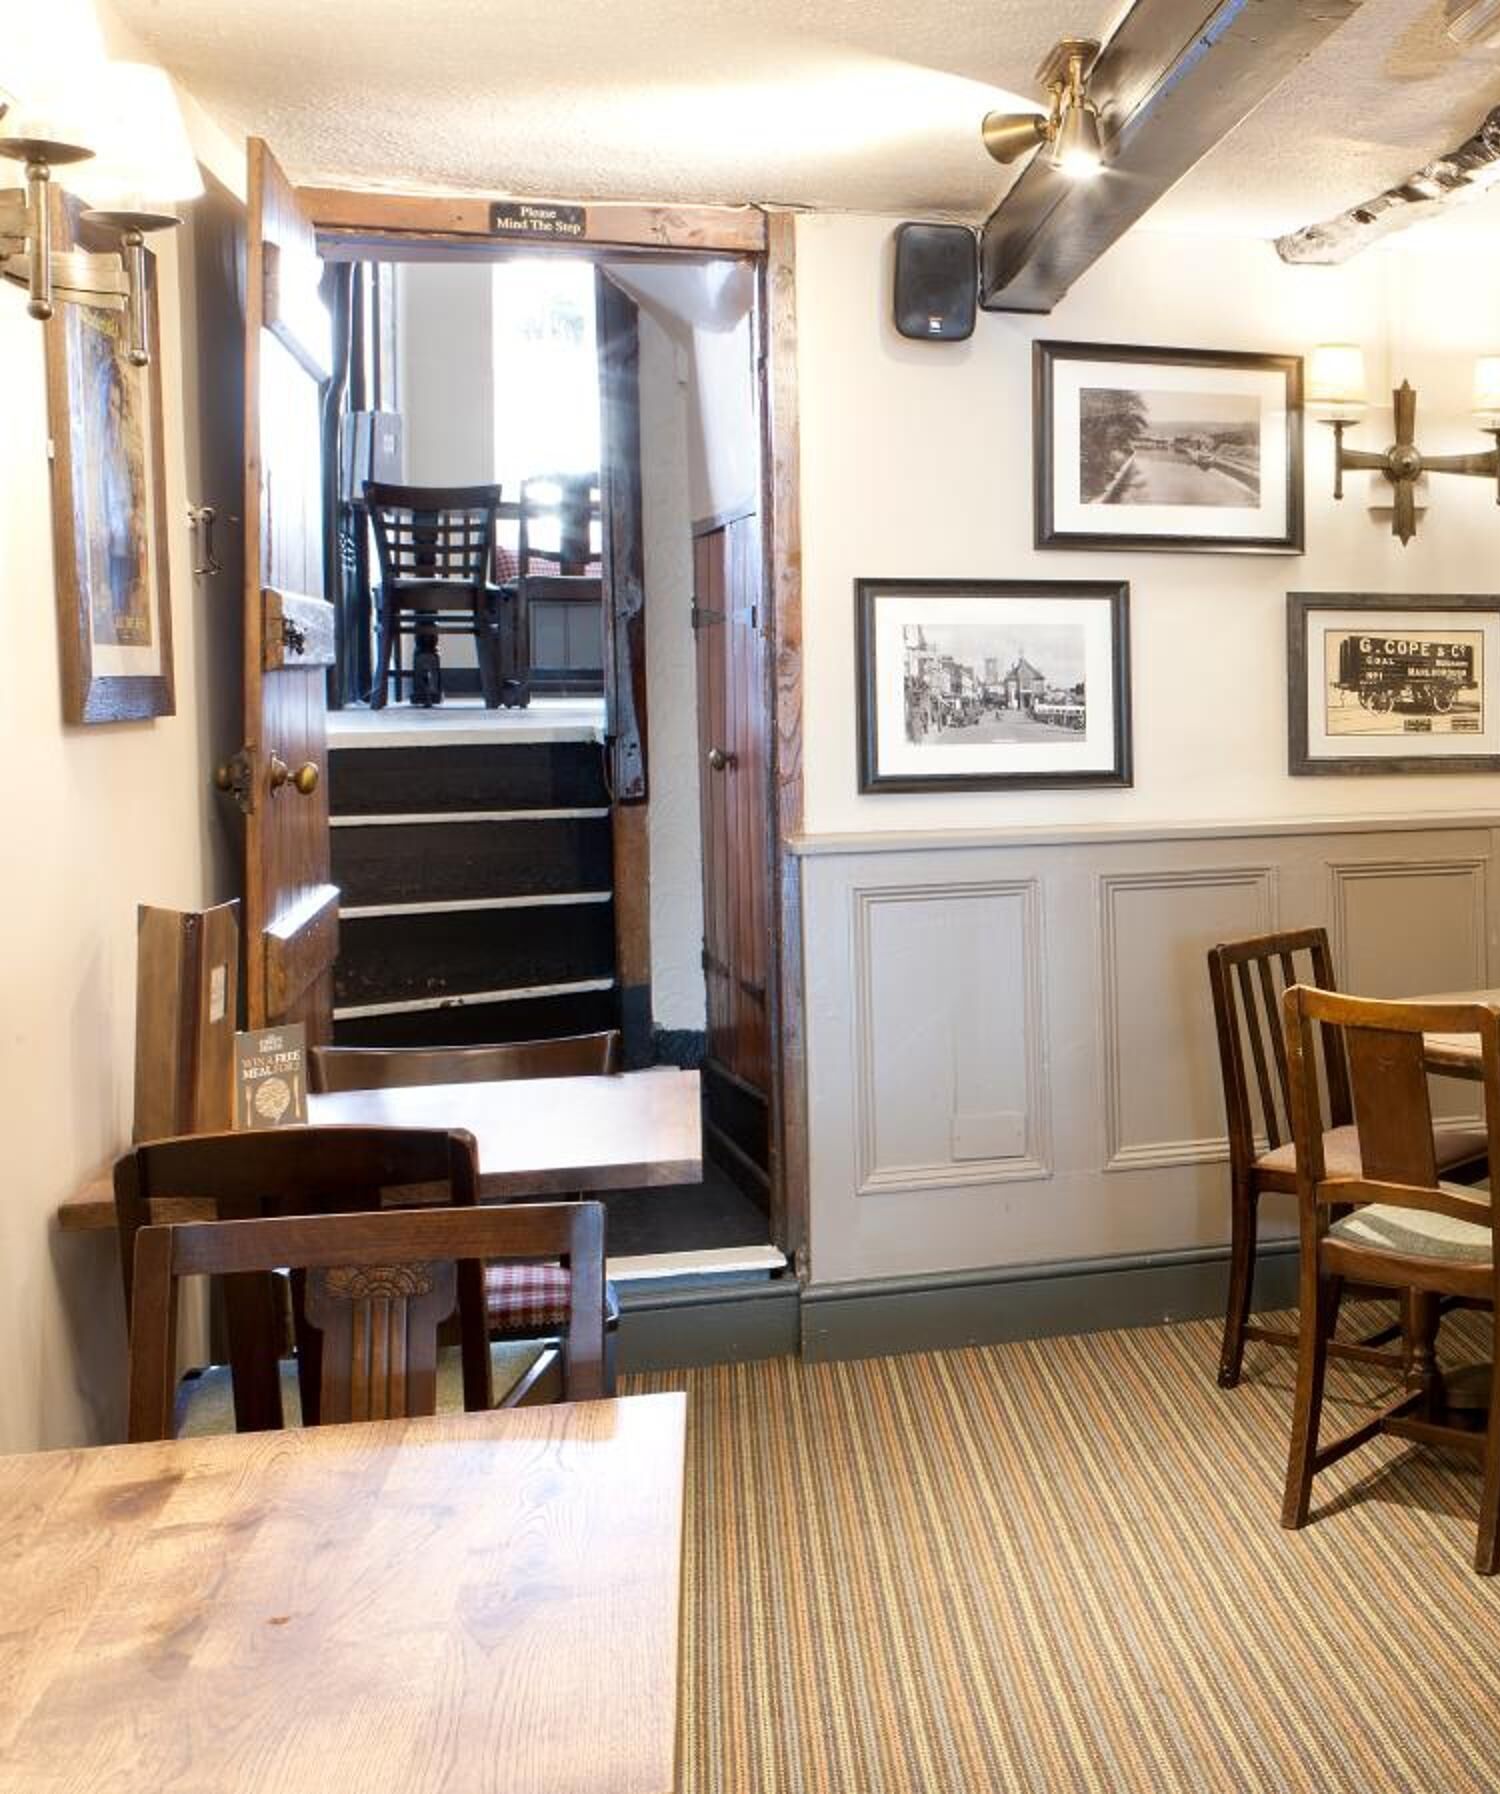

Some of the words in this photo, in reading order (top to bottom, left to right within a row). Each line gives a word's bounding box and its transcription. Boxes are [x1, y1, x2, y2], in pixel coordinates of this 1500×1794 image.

[521, 206, 557, 219] Please
[497, 217, 528, 230] Mind
[530, 219, 553, 231] The
[555, 221, 581, 235] Step
[1384, 640, 1431, 658] COPE
[275, 1050, 301, 1064] FREE
[242, 1065, 273, 1080] MEAL
